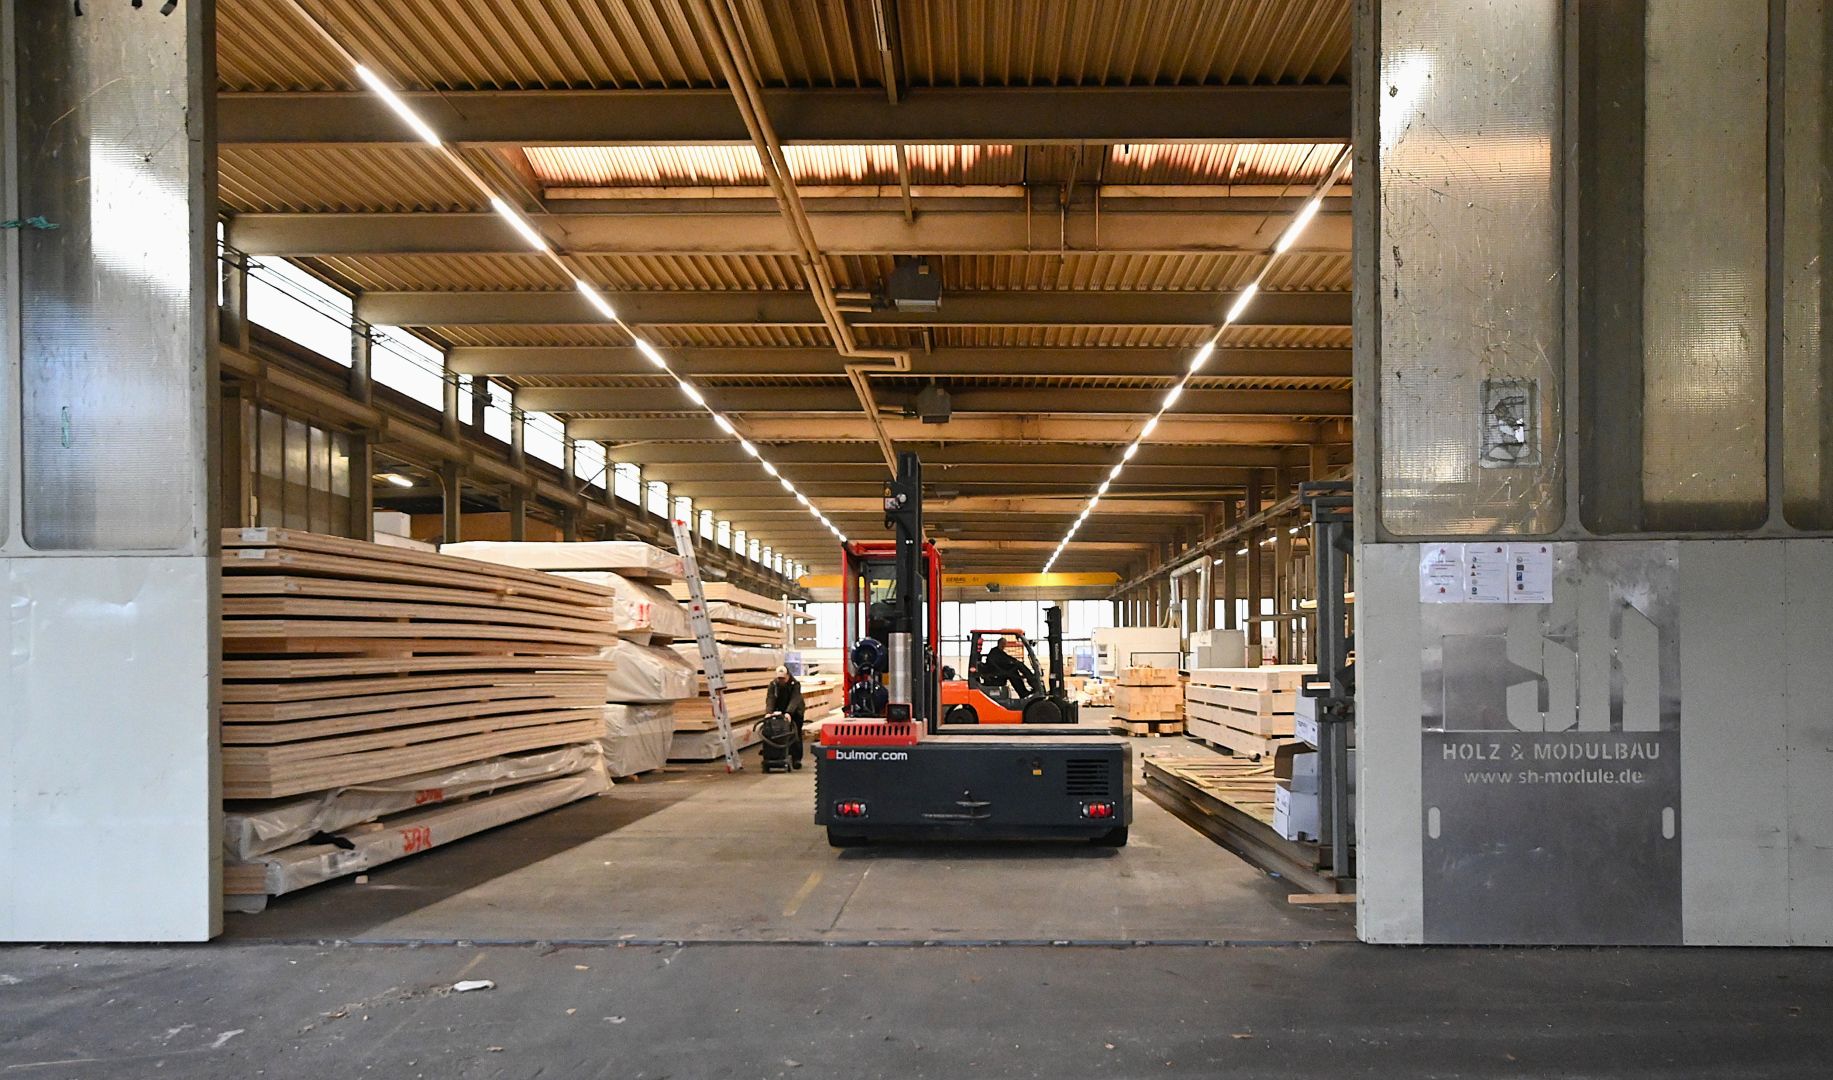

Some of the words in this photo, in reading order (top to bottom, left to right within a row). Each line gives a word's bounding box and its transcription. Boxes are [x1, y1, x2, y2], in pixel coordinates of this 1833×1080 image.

[836, 749, 908, 760] bulmor.com
[1443, 743, 1500, 760] HOLZ
[1511, 743, 1524, 760] &
[1534, 742, 1660, 760] MODULBAU
